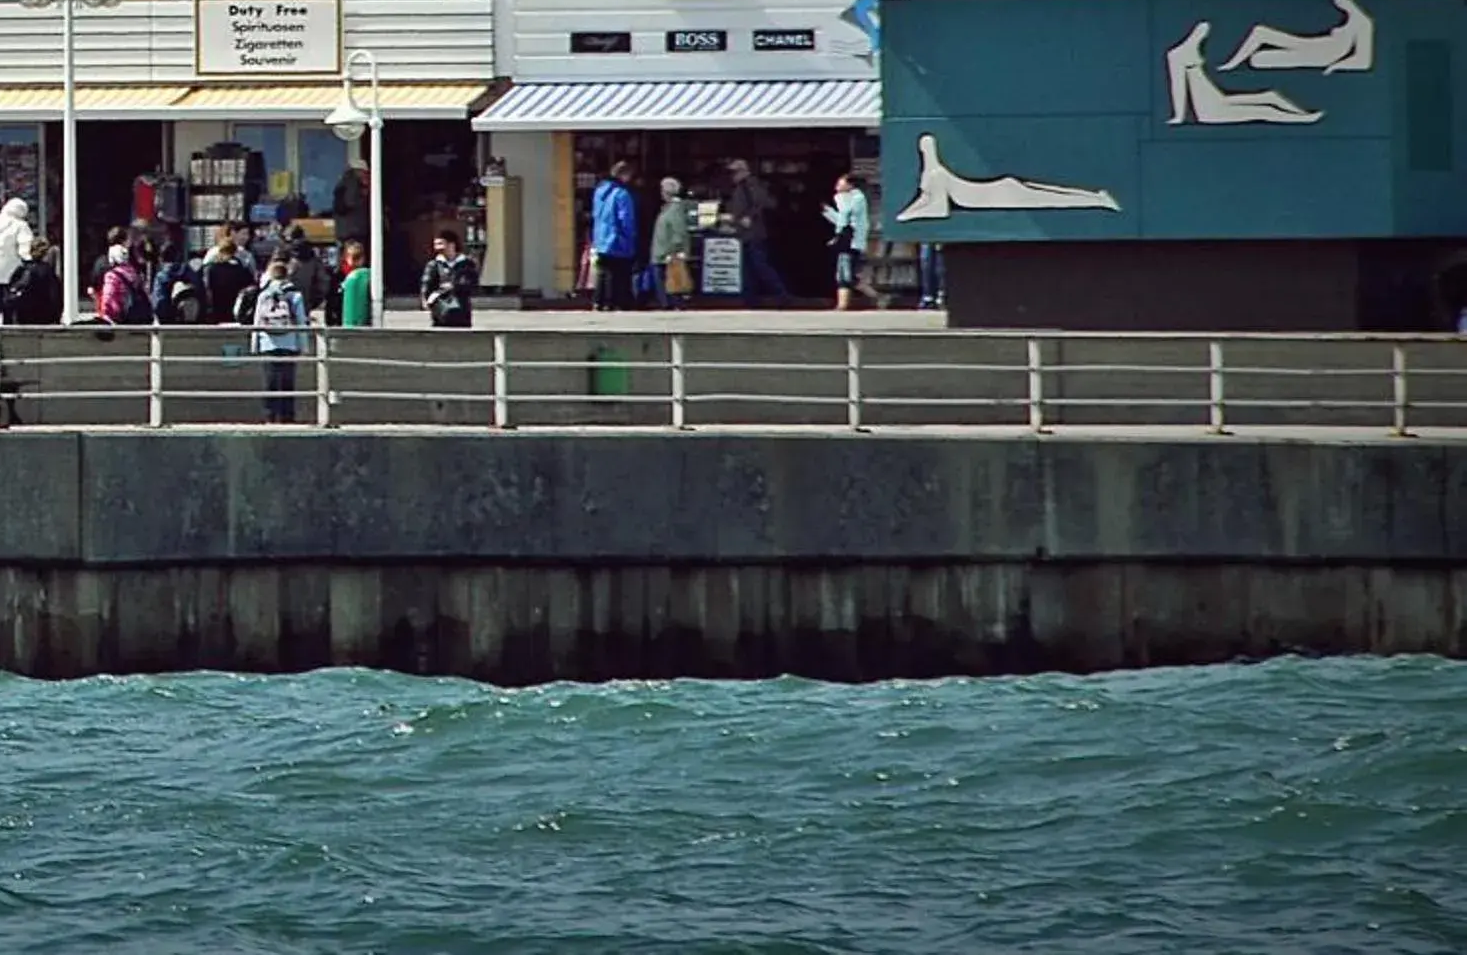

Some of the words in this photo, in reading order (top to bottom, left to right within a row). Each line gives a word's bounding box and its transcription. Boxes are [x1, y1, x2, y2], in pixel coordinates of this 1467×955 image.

[229, 5, 263, 17] Duty
[276, 5, 308, 16] Free
[232, 21, 304, 34] Spirituosen
[675, 32, 719, 46] BOSS
[755, 34, 813, 46] CHANEL
[235, 39, 303, 53] Zigaretten
[240, 54, 297, 65] Souvenir
